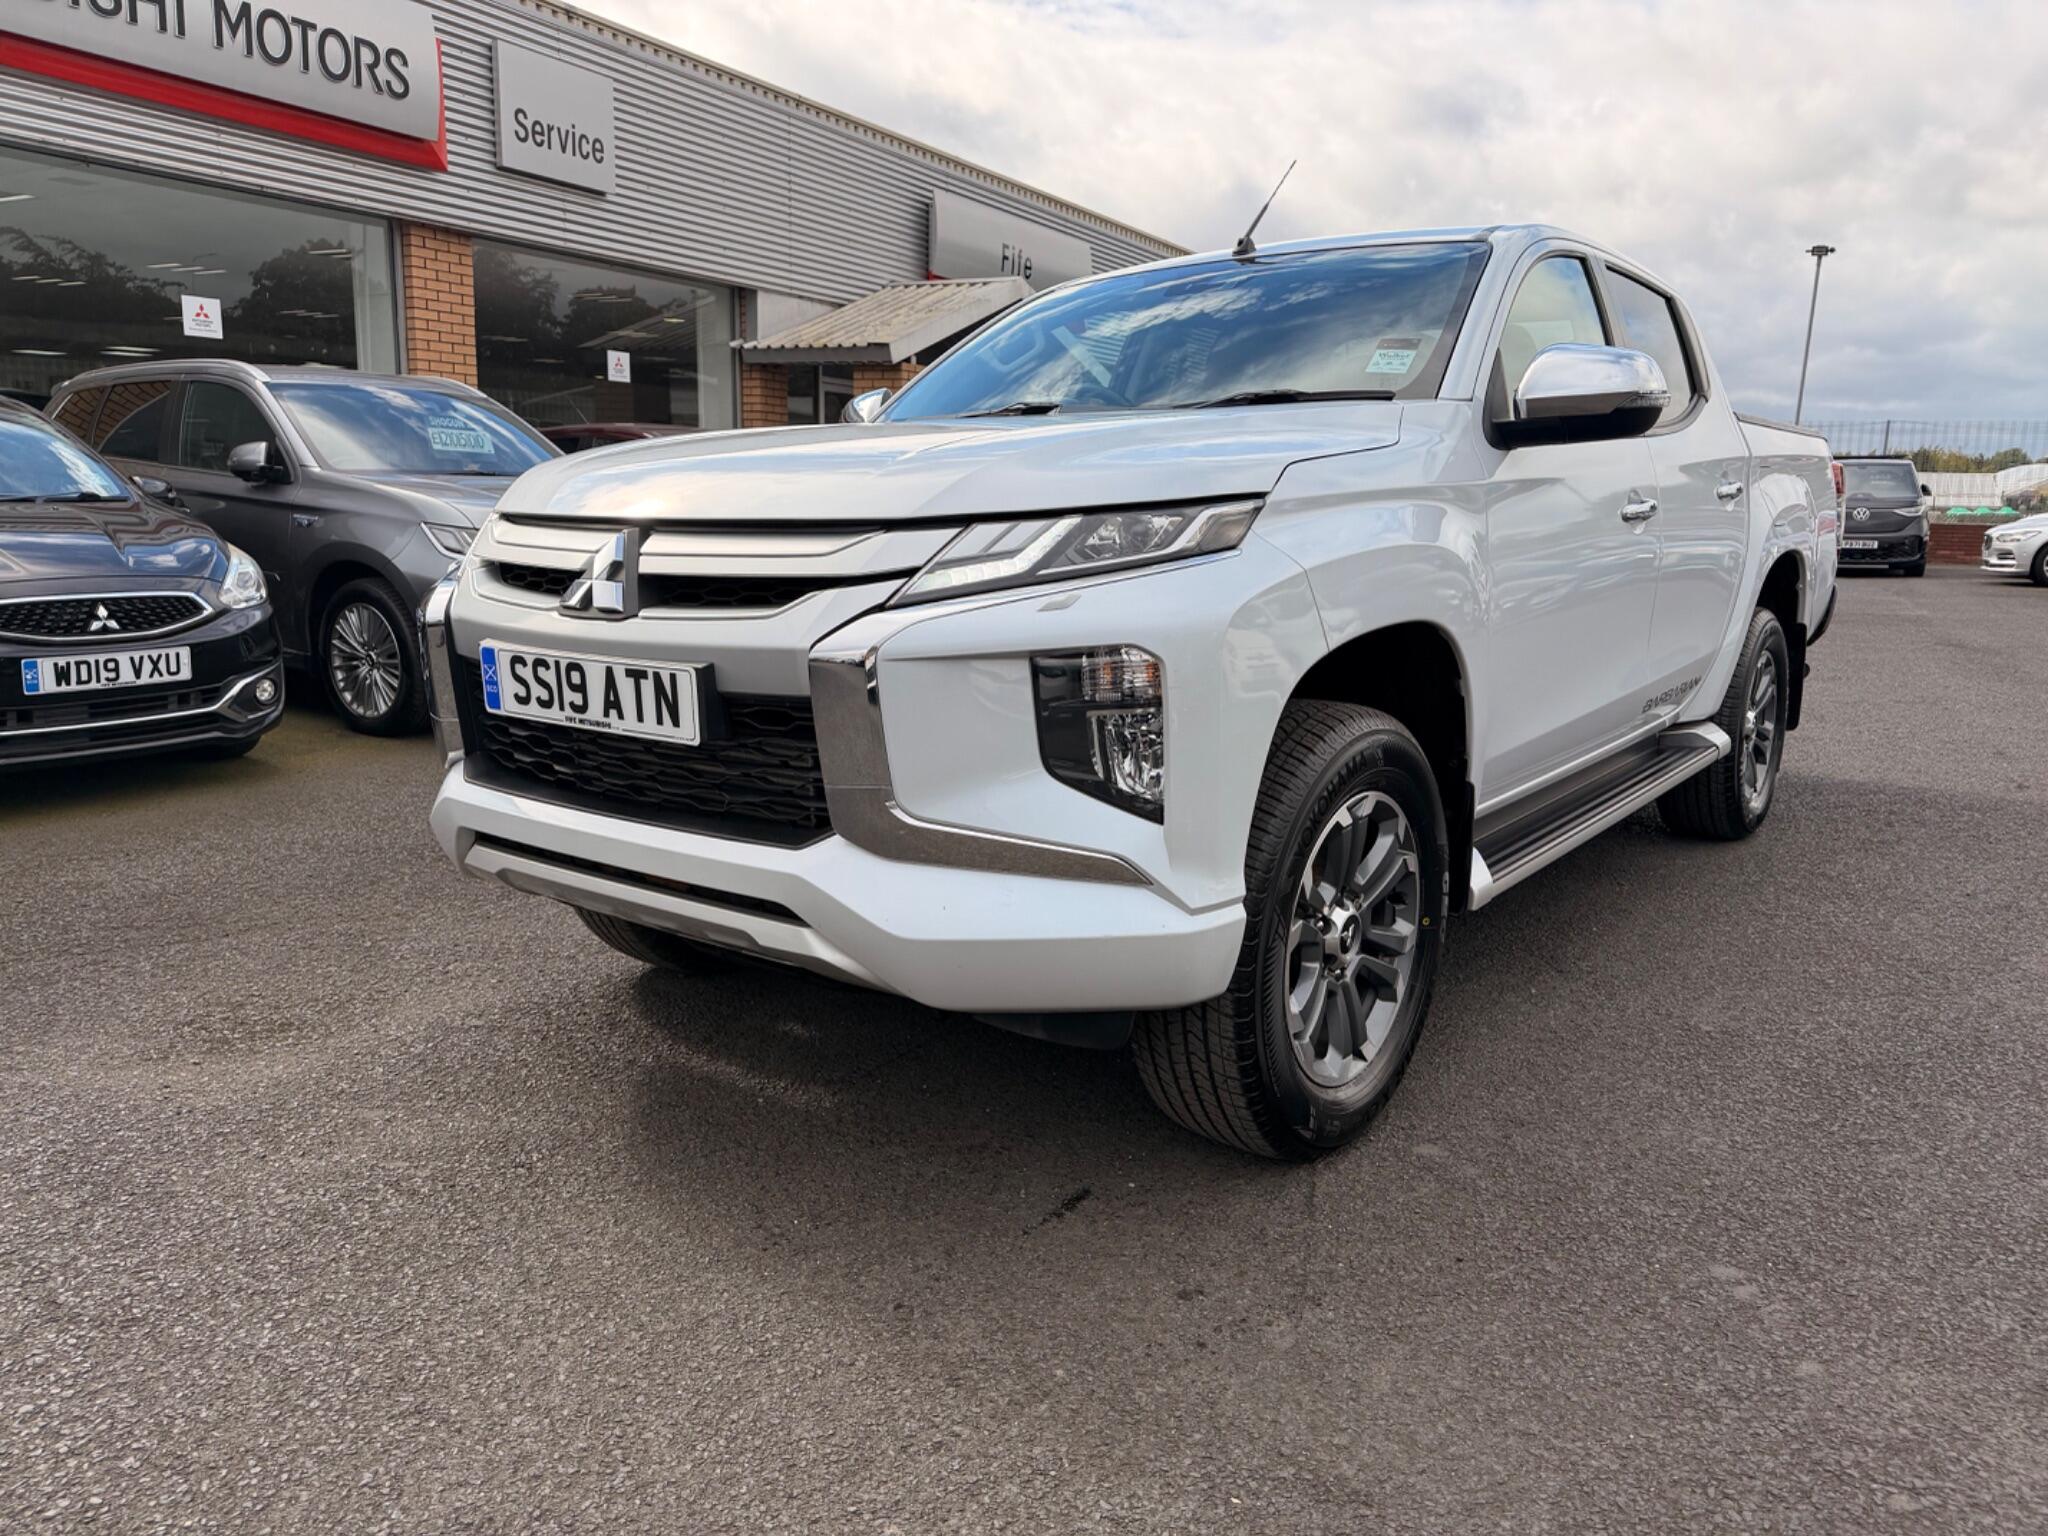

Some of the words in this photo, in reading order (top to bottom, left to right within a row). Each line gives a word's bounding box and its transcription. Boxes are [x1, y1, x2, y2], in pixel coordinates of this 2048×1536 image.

[213, 0, 410, 100] MOTORS
[514, 107, 605, 165] Service
[1001, 242, 1032, 280] Fife
[53, 658, 120, 687] WD19
[129, 651, 181, 680] VXU
[509, 654, 589, 715] SS19
[603, 665, 681, 728] ATN
